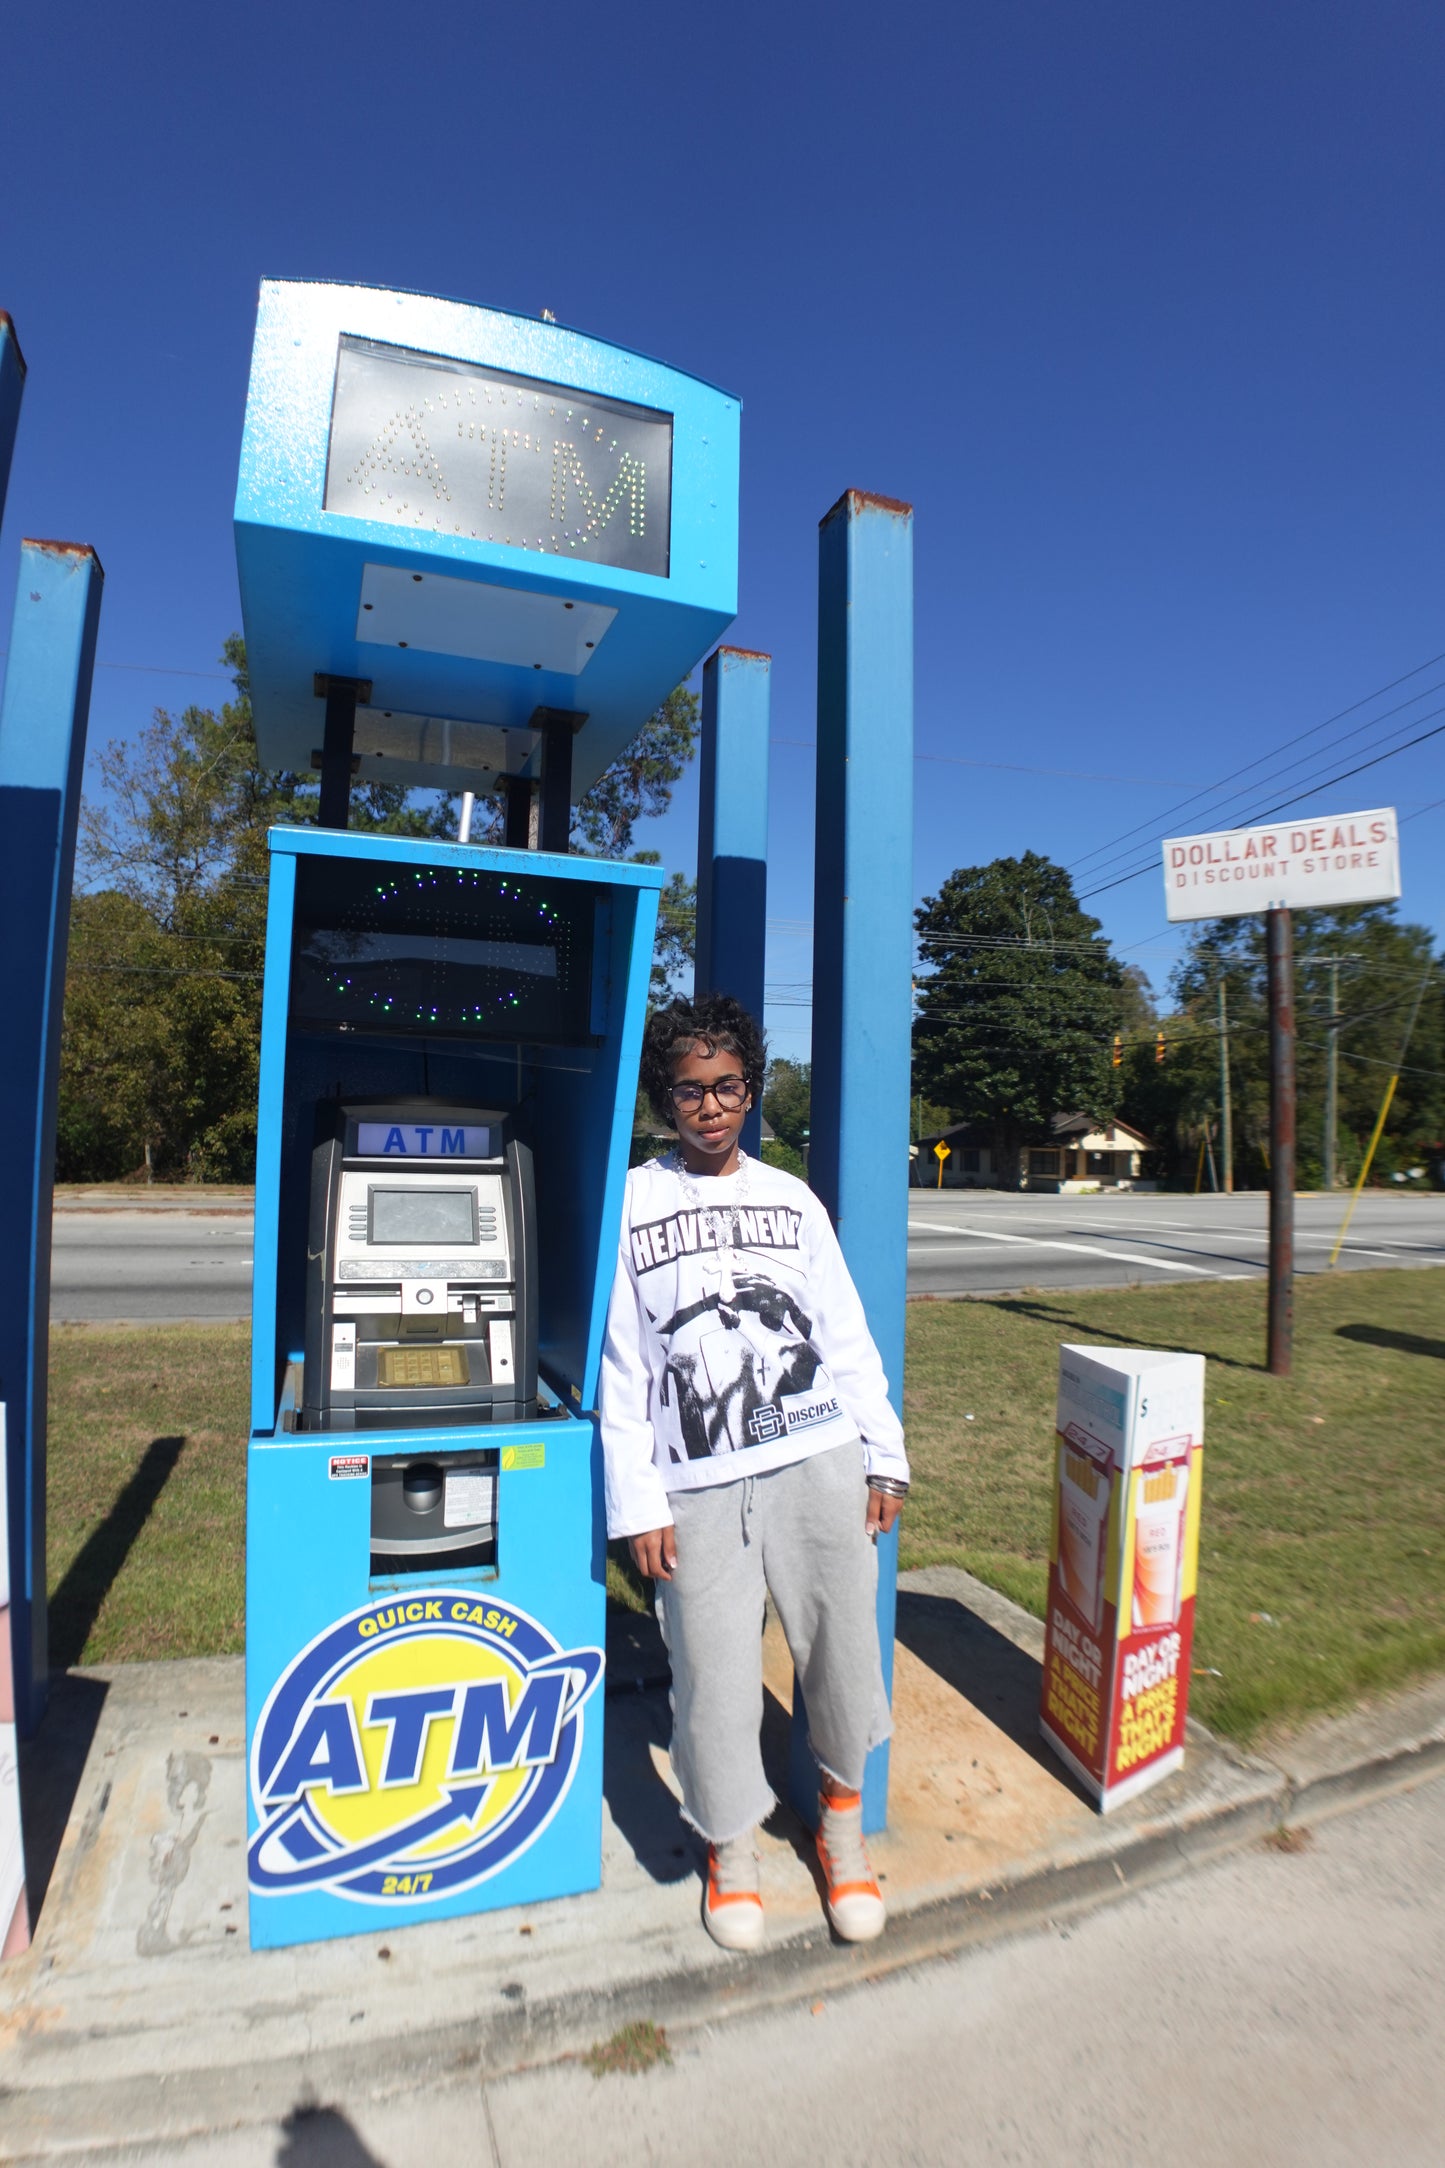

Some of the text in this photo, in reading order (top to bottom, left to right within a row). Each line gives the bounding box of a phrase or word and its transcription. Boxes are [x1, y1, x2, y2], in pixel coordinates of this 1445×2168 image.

[347, 410, 646, 538] ATM
[1171, 821, 1388, 868] DOLLAR DEALS
[1176, 851, 1379, 887] DISCOUNT STORE
[384, 1126, 466, 1154] ATM
[631, 1210, 734, 1272] HEAVEN
[787, 1397, 839, 1424] DISCIPLE
[1067, 1428, 1106, 1457] 24/7
[1146, 1441, 1187, 1460] 247
[333, 1458, 366, 1466] NOTICE
[357, 1600, 519, 1638] QUICK CASH
[1053, 1608, 1081, 1646] DAY
[1052, 1625, 1102, 1690] NIGHT
[1123, 1643, 1159, 1676] DAY
[1051, 1654, 1101, 1714] A PRICE
[1122, 1653, 1178, 1701] NIGHT
[260, 1667, 571, 1805] ATM
[1048, 1688, 1099, 1757] RIGHT
[1115, 1720, 1172, 1773] RIGHT
[381, 1873, 433, 1895] 24/7
